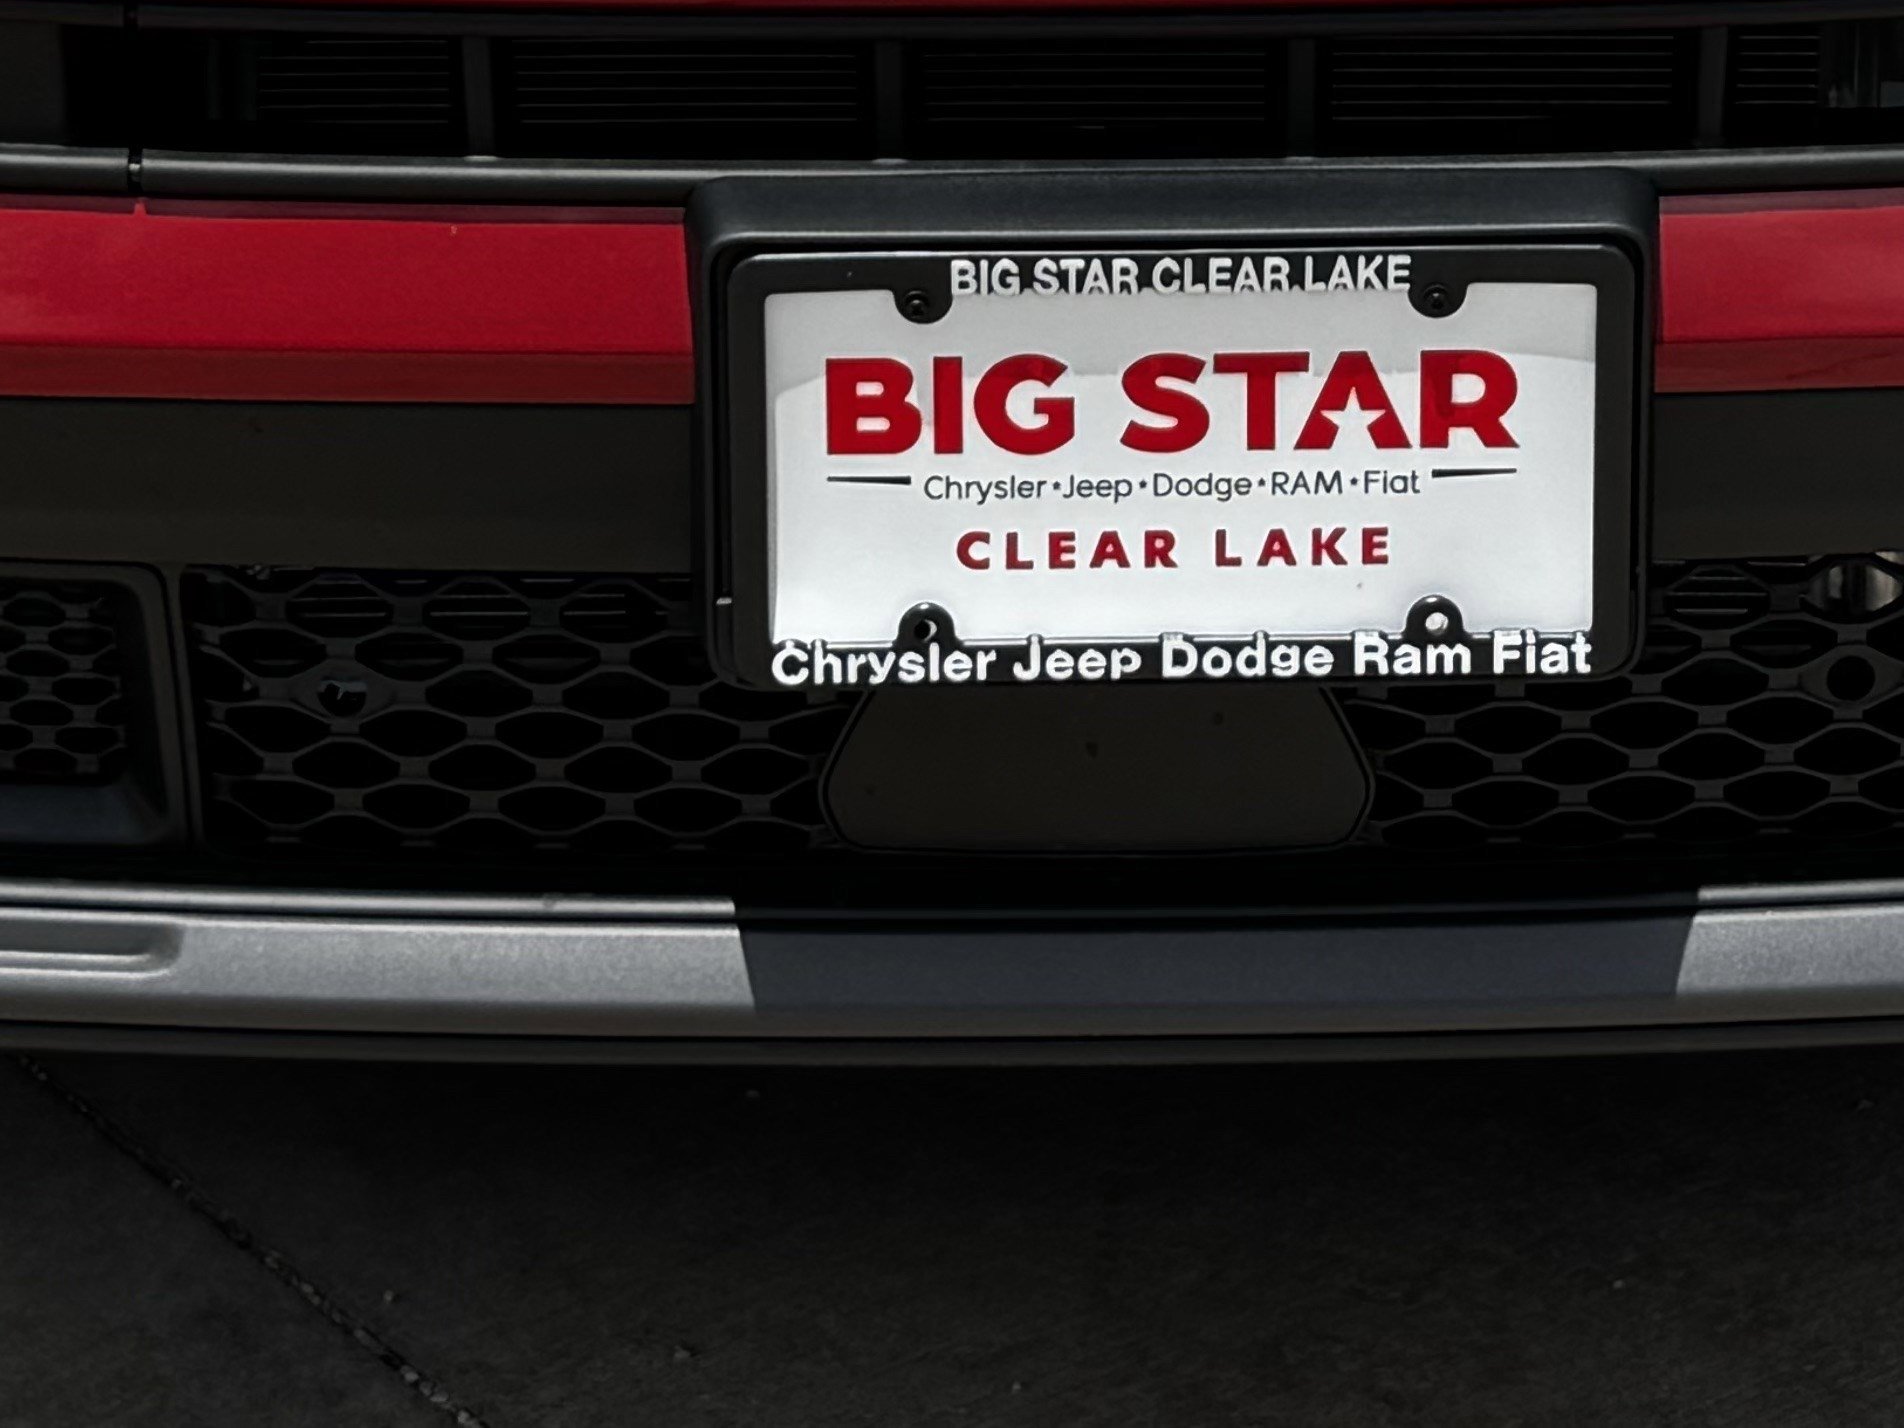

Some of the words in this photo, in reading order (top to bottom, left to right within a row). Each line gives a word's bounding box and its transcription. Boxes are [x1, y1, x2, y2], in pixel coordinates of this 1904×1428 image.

[950, 259, 1021, 296] BIG
[1032, 258, 1138, 295] STAR
[1151, 256, 1290, 293] CLEAR
[1303, 254, 1412, 292] LAKE
[825, 354, 1076, 456] BIG
[1120, 350, 1519, 453] STAR
[956, 530, 1178, 571] CLEAR
[1215, 526, 1390, 566] LAKE
[771, 638, 996, 686] Chrysler
[1013, 634, 1143, 682] Jeep
[1159, 631, 1335, 681] Dodge
[1353, 634, 1472, 676] Ram
[1492, 630, 1593, 676] Fiat
